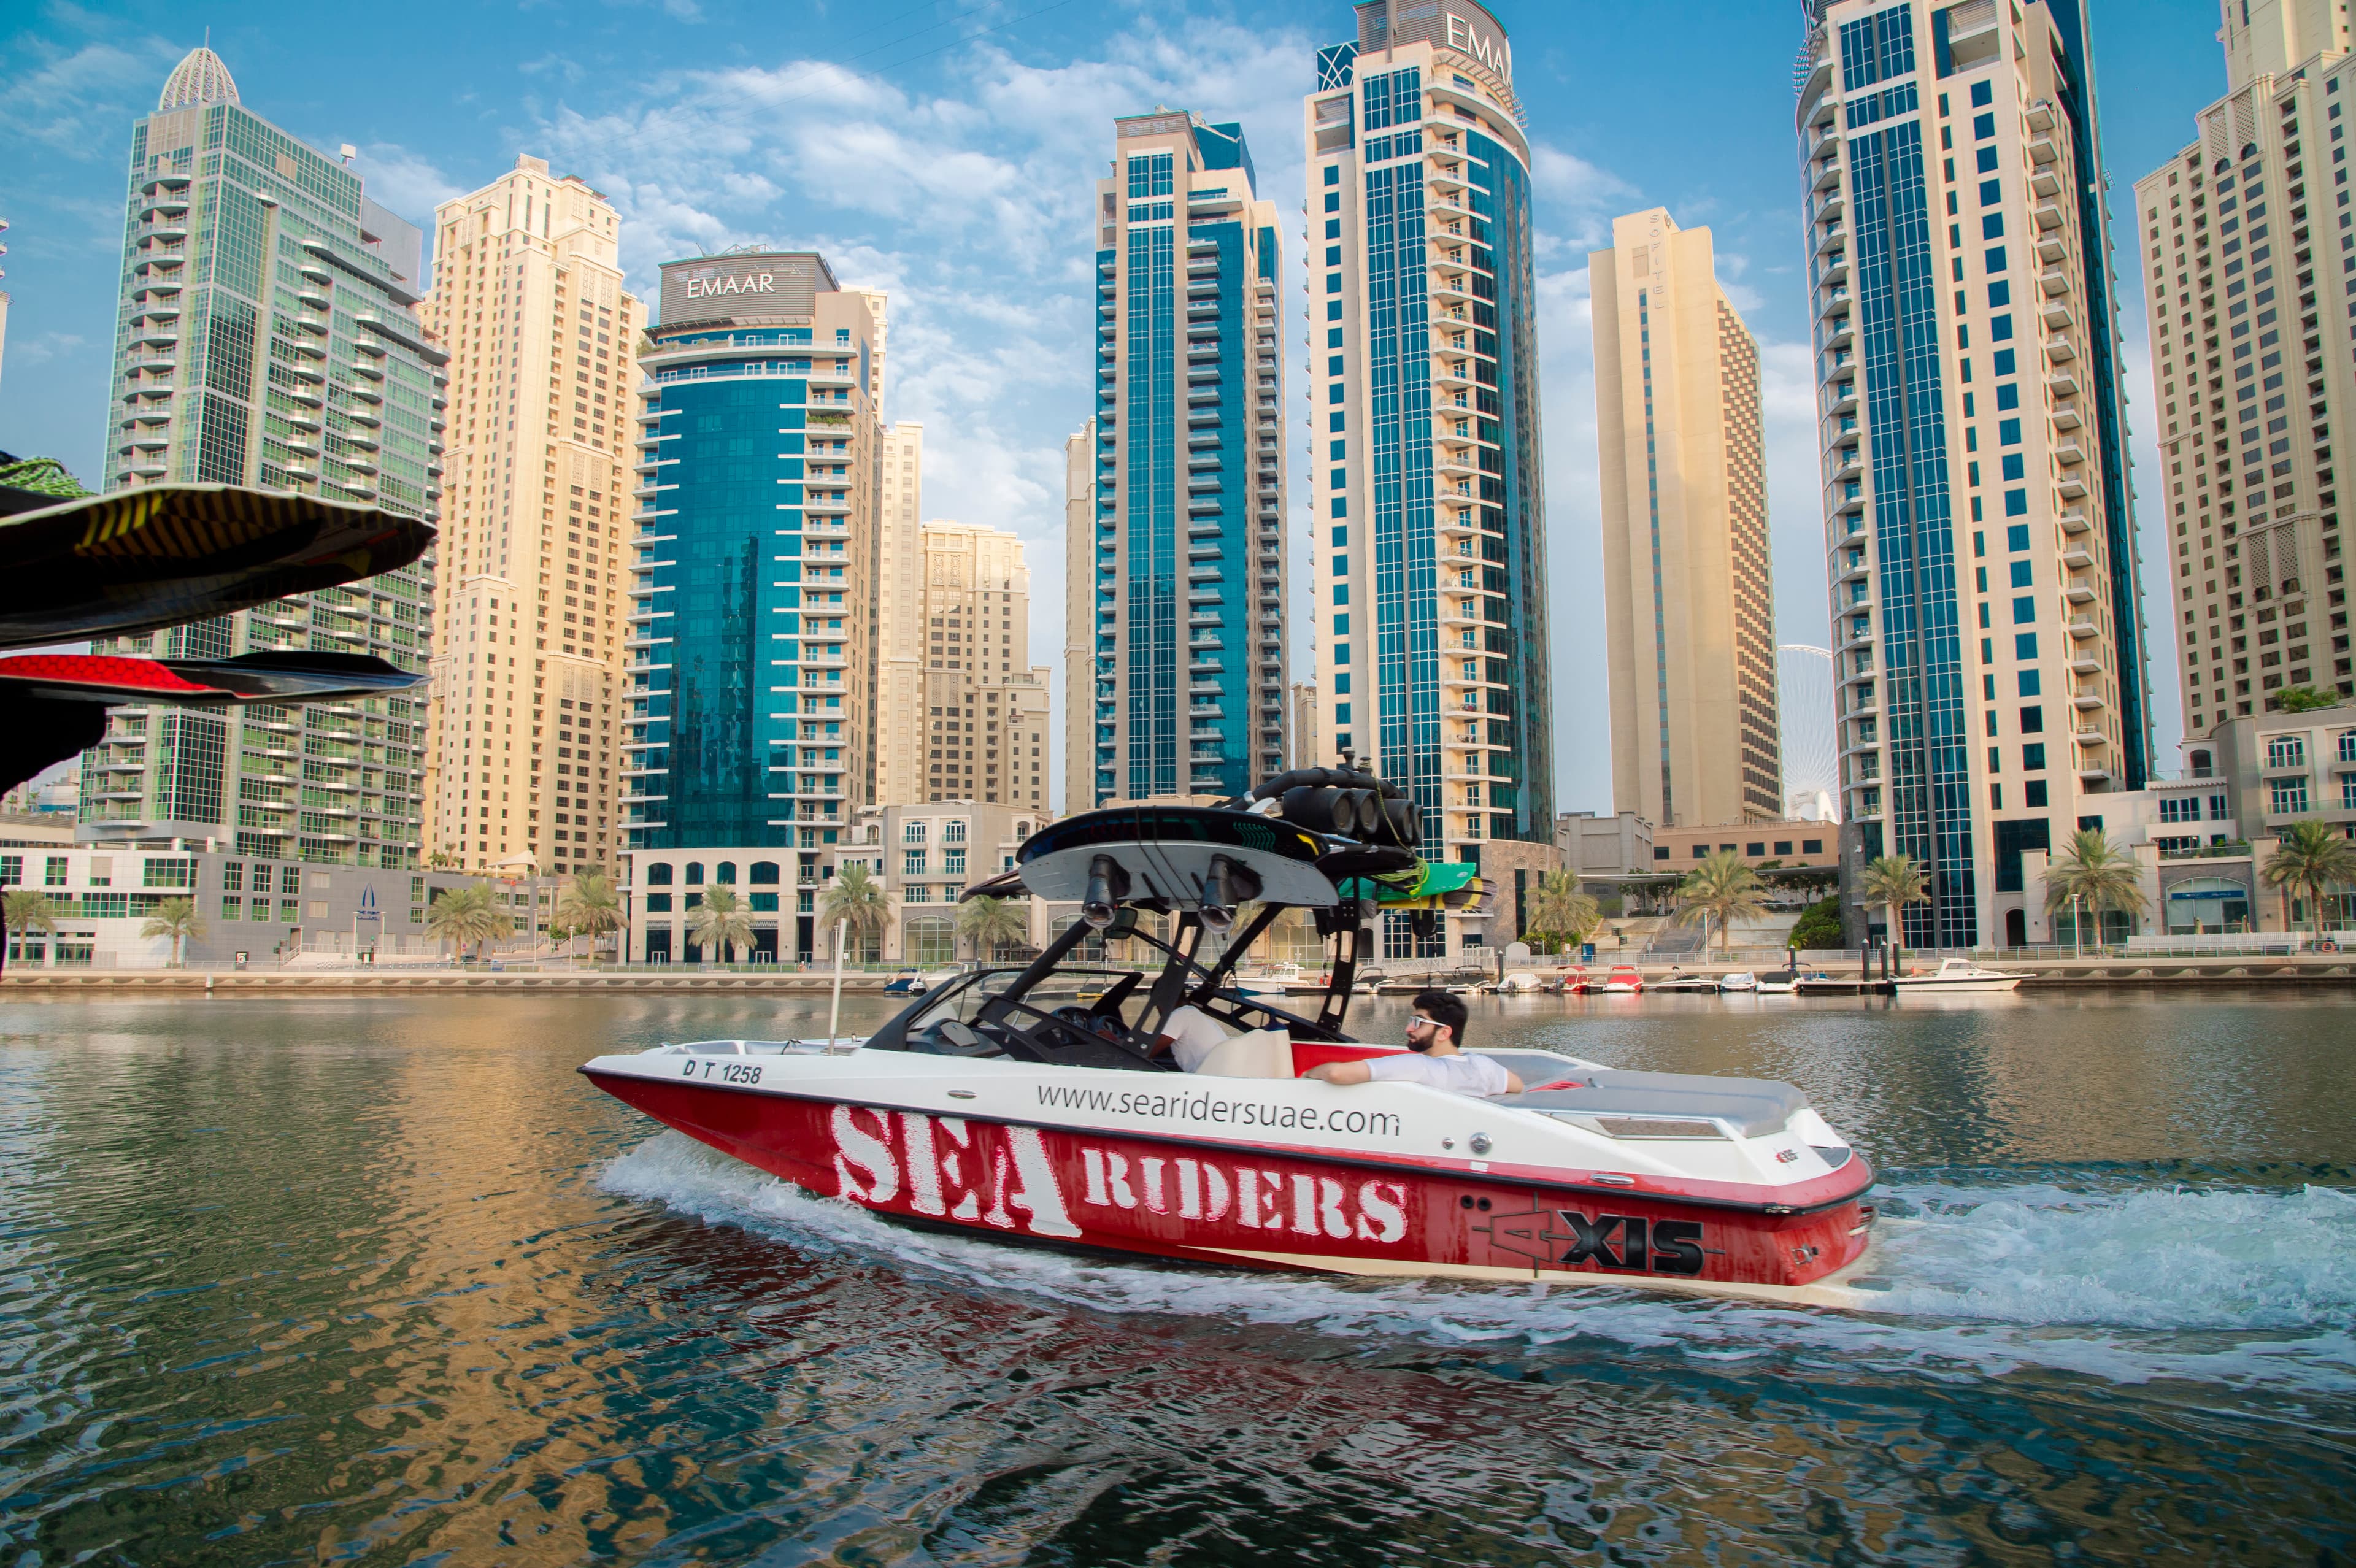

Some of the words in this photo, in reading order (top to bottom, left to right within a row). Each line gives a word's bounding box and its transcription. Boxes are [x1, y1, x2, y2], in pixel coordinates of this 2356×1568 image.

[687, 273, 776, 299] EMAAR
[683, 1059, 697, 1076] D
[704, 1061, 717, 1078] T
[723, 1064, 763, 1084] 1258
[1038, 1085, 1399, 1136] www.searidersuae.com
[831, 1105, 1082, 1238] SEA
[1082, 1147, 1408, 1243] RIDERS
